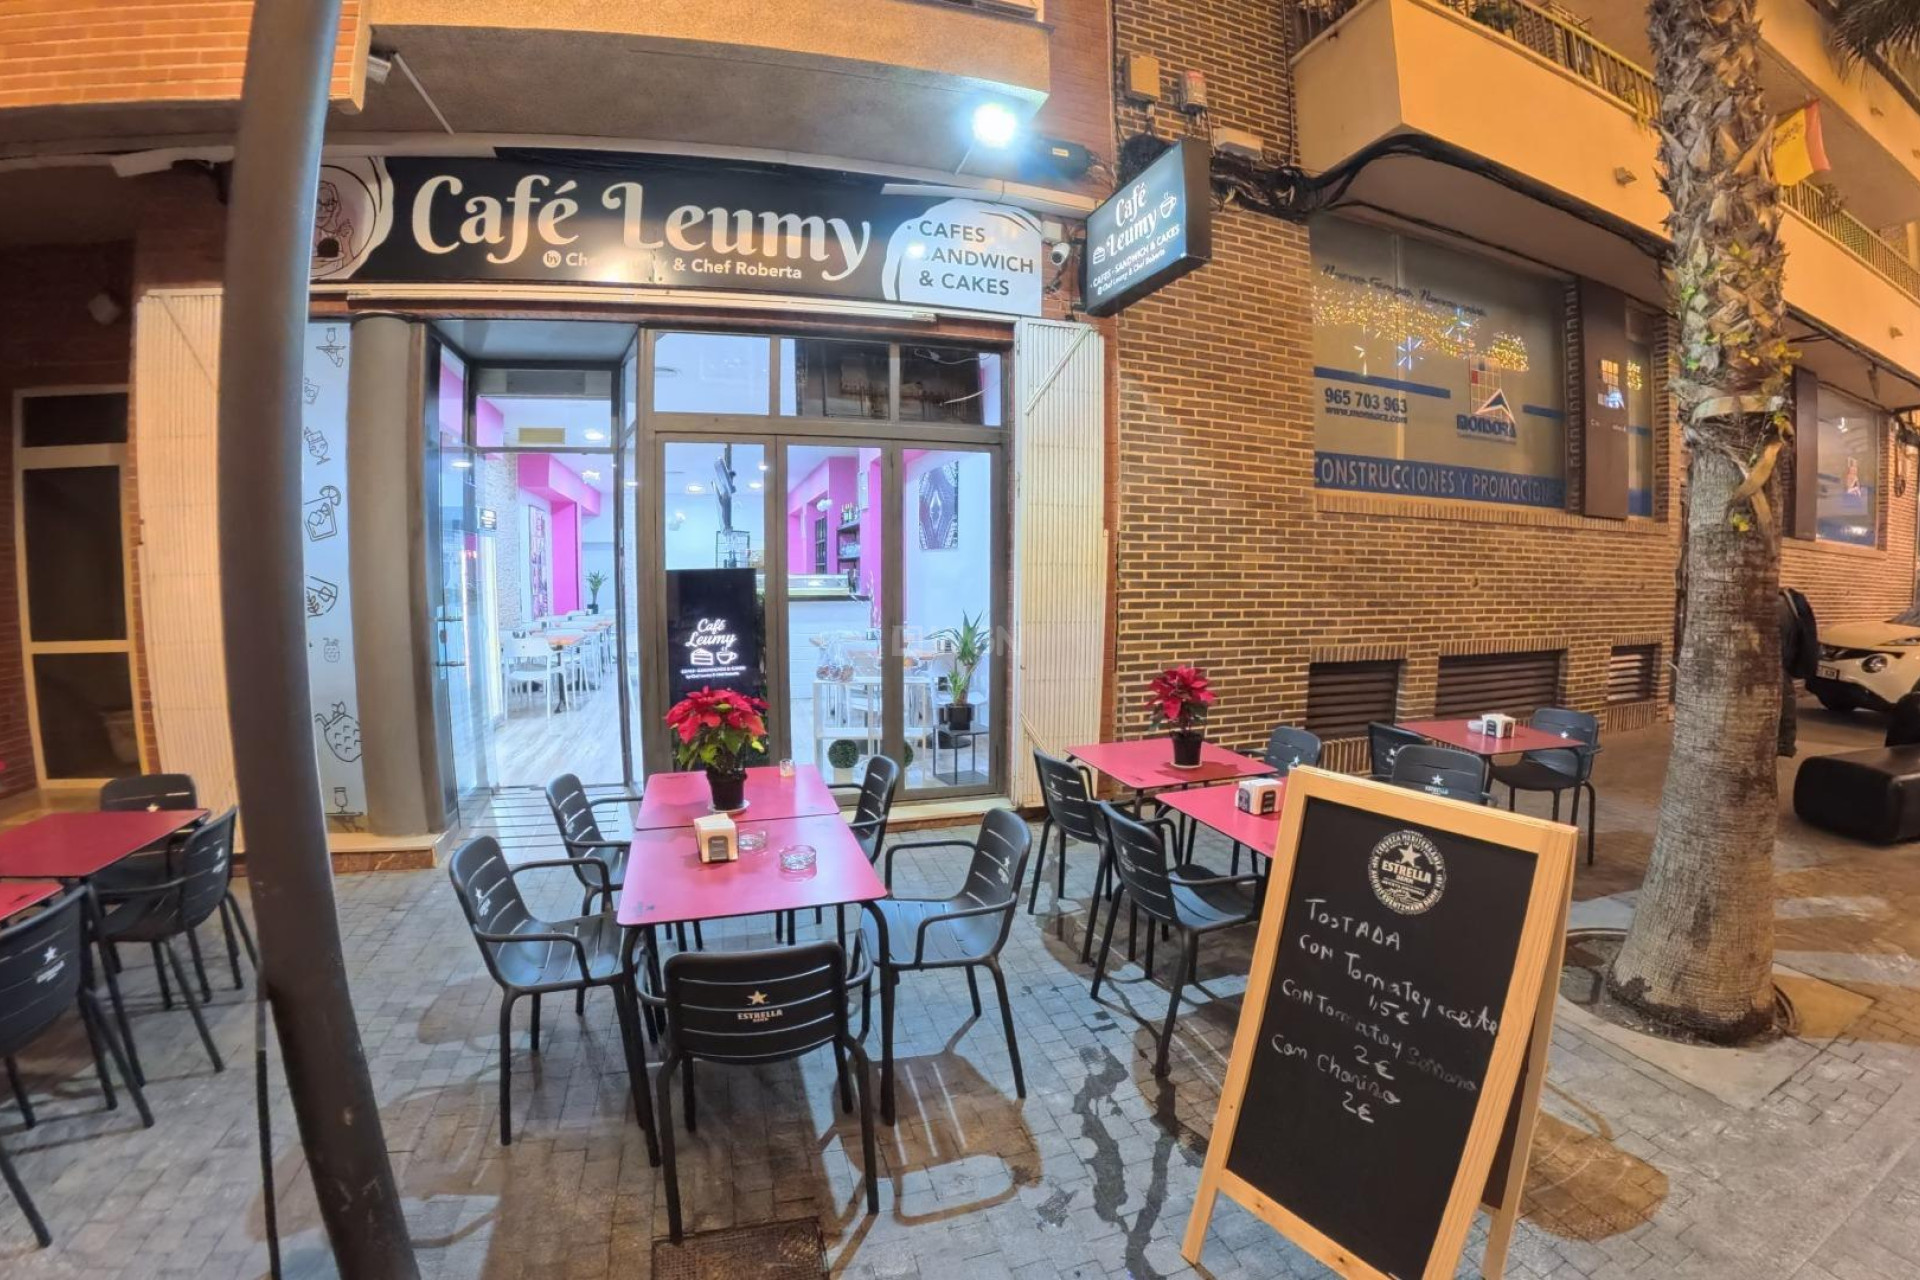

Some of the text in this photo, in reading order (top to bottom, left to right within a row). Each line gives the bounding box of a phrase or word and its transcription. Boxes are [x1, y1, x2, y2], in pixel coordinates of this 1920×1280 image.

[412, 175, 871, 281] Café Leumy
[919, 220, 985, 243] CAFES
[1106, 182, 1157, 257] Café Leumy
[672, 258, 686, 272] &
[691, 258, 732, 275] Chef
[735, 262, 802, 279] Roberta
[924, 247, 1034, 274] ANDWICH
[918, 270, 1009, 296] & CAKES
[1324, 387, 1408, 414] 965 703 963
[1314, 457, 1455, 494] ONSTRUCCIONES
[1460, 471, 1468, 496] Y
[697, 618, 726, 634] Café
[685, 631, 738, 648] Leumy
[1381, 859, 1432, 884] ESTRELLA
[737, 1009, 784, 1020] ESTRELLA
